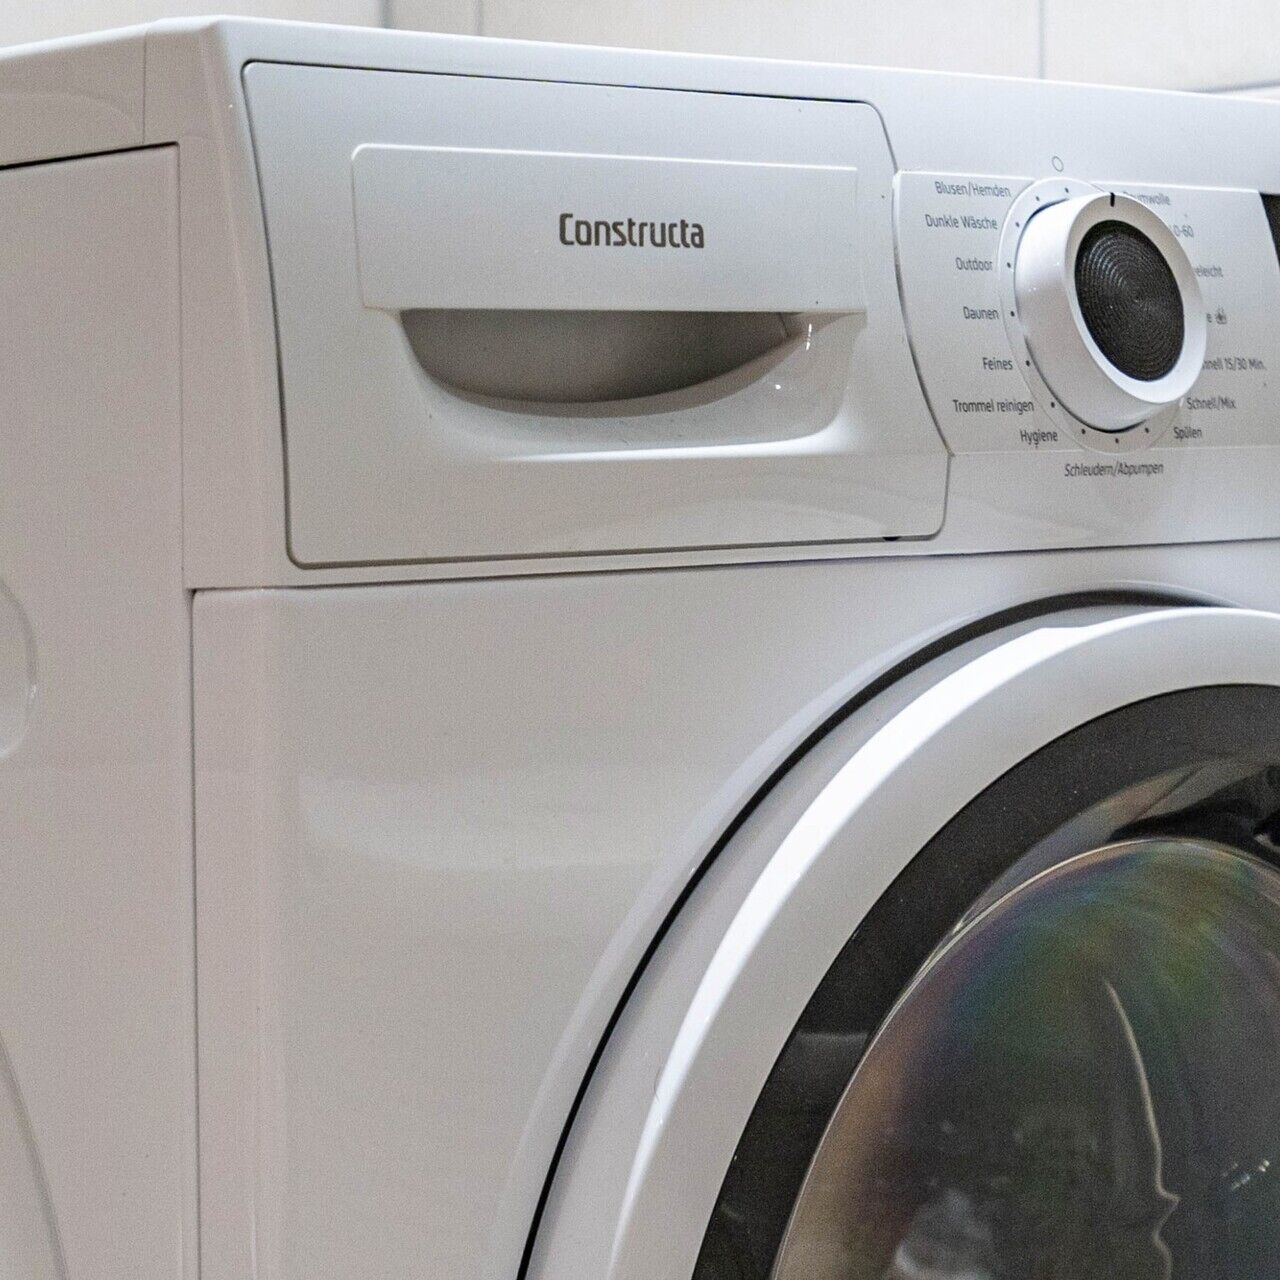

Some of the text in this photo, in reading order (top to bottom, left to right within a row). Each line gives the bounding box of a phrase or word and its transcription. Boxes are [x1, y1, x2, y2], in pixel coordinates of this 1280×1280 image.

[934, 180, 1012, 198] Blusen/Hemden
[559, 202, 705, 249] Constructa
[924, 213, 999, 230] Dunkle Wäsche
[955, 256, 993, 272] Outdoor
[962, 305, 1000, 320] Daunen
[982, 356, 1014, 371] Feines
[952, 398, 1035, 416] Trommel reinigen
[1186, 396, 1236, 411] Schnell/Mix
[1020, 428, 1058, 448] Hygiene
[1173, 425, 1203, 441] Spülen
[1064, 460, 1164, 478] Schleudern/Abpumpen
